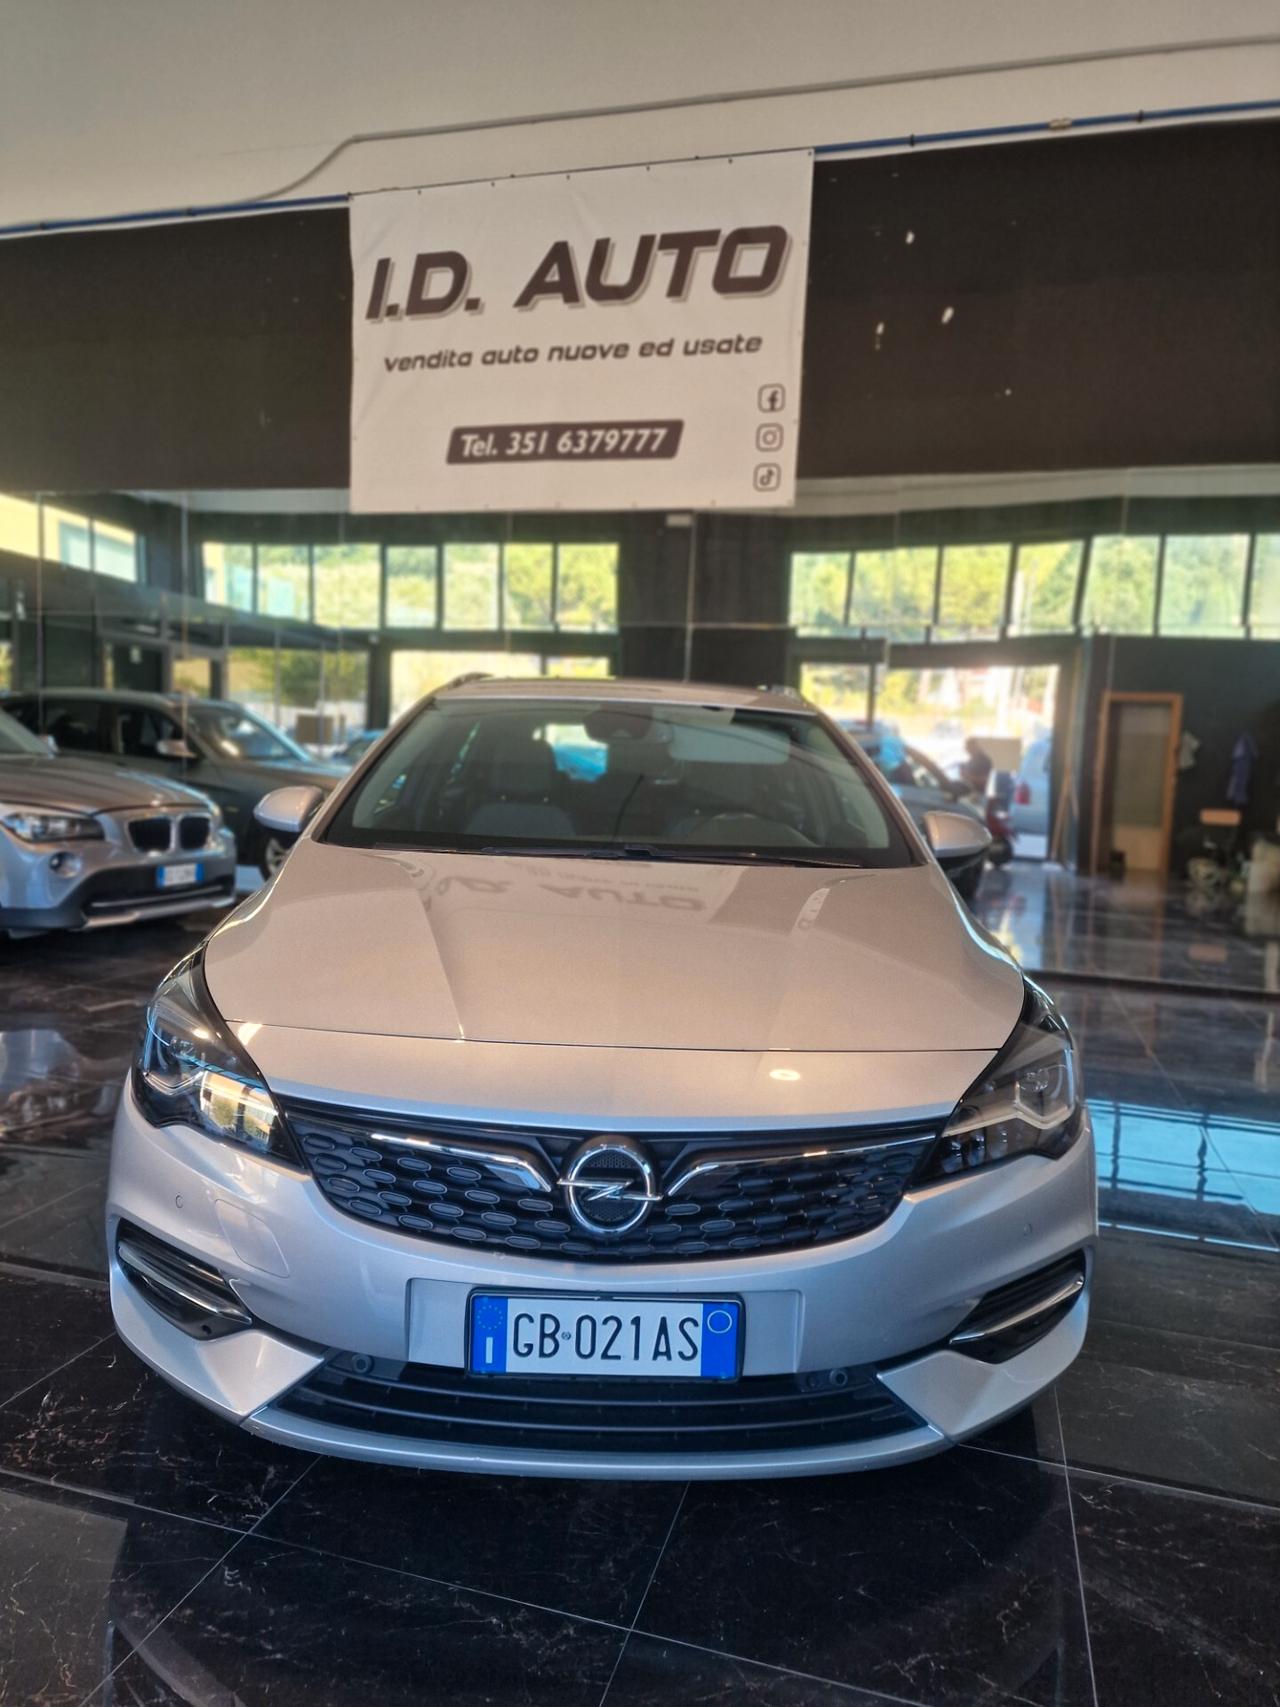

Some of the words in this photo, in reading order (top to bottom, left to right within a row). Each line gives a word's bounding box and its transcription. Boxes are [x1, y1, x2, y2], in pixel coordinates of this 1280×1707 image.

[365, 251, 484, 322] I.D.
[513, 224, 793, 309] AUTO
[384, 350, 473, 372] vendita
[481, 346, 539, 365] auto
[547, 342, 630, 362] nuove
[638, 338, 675, 357] ed
[683, 334, 763, 356] usate
[460, 433, 498, 457] Tel.
[505, 431, 548, 455] 351
[556, 428, 668, 453] 6379777
